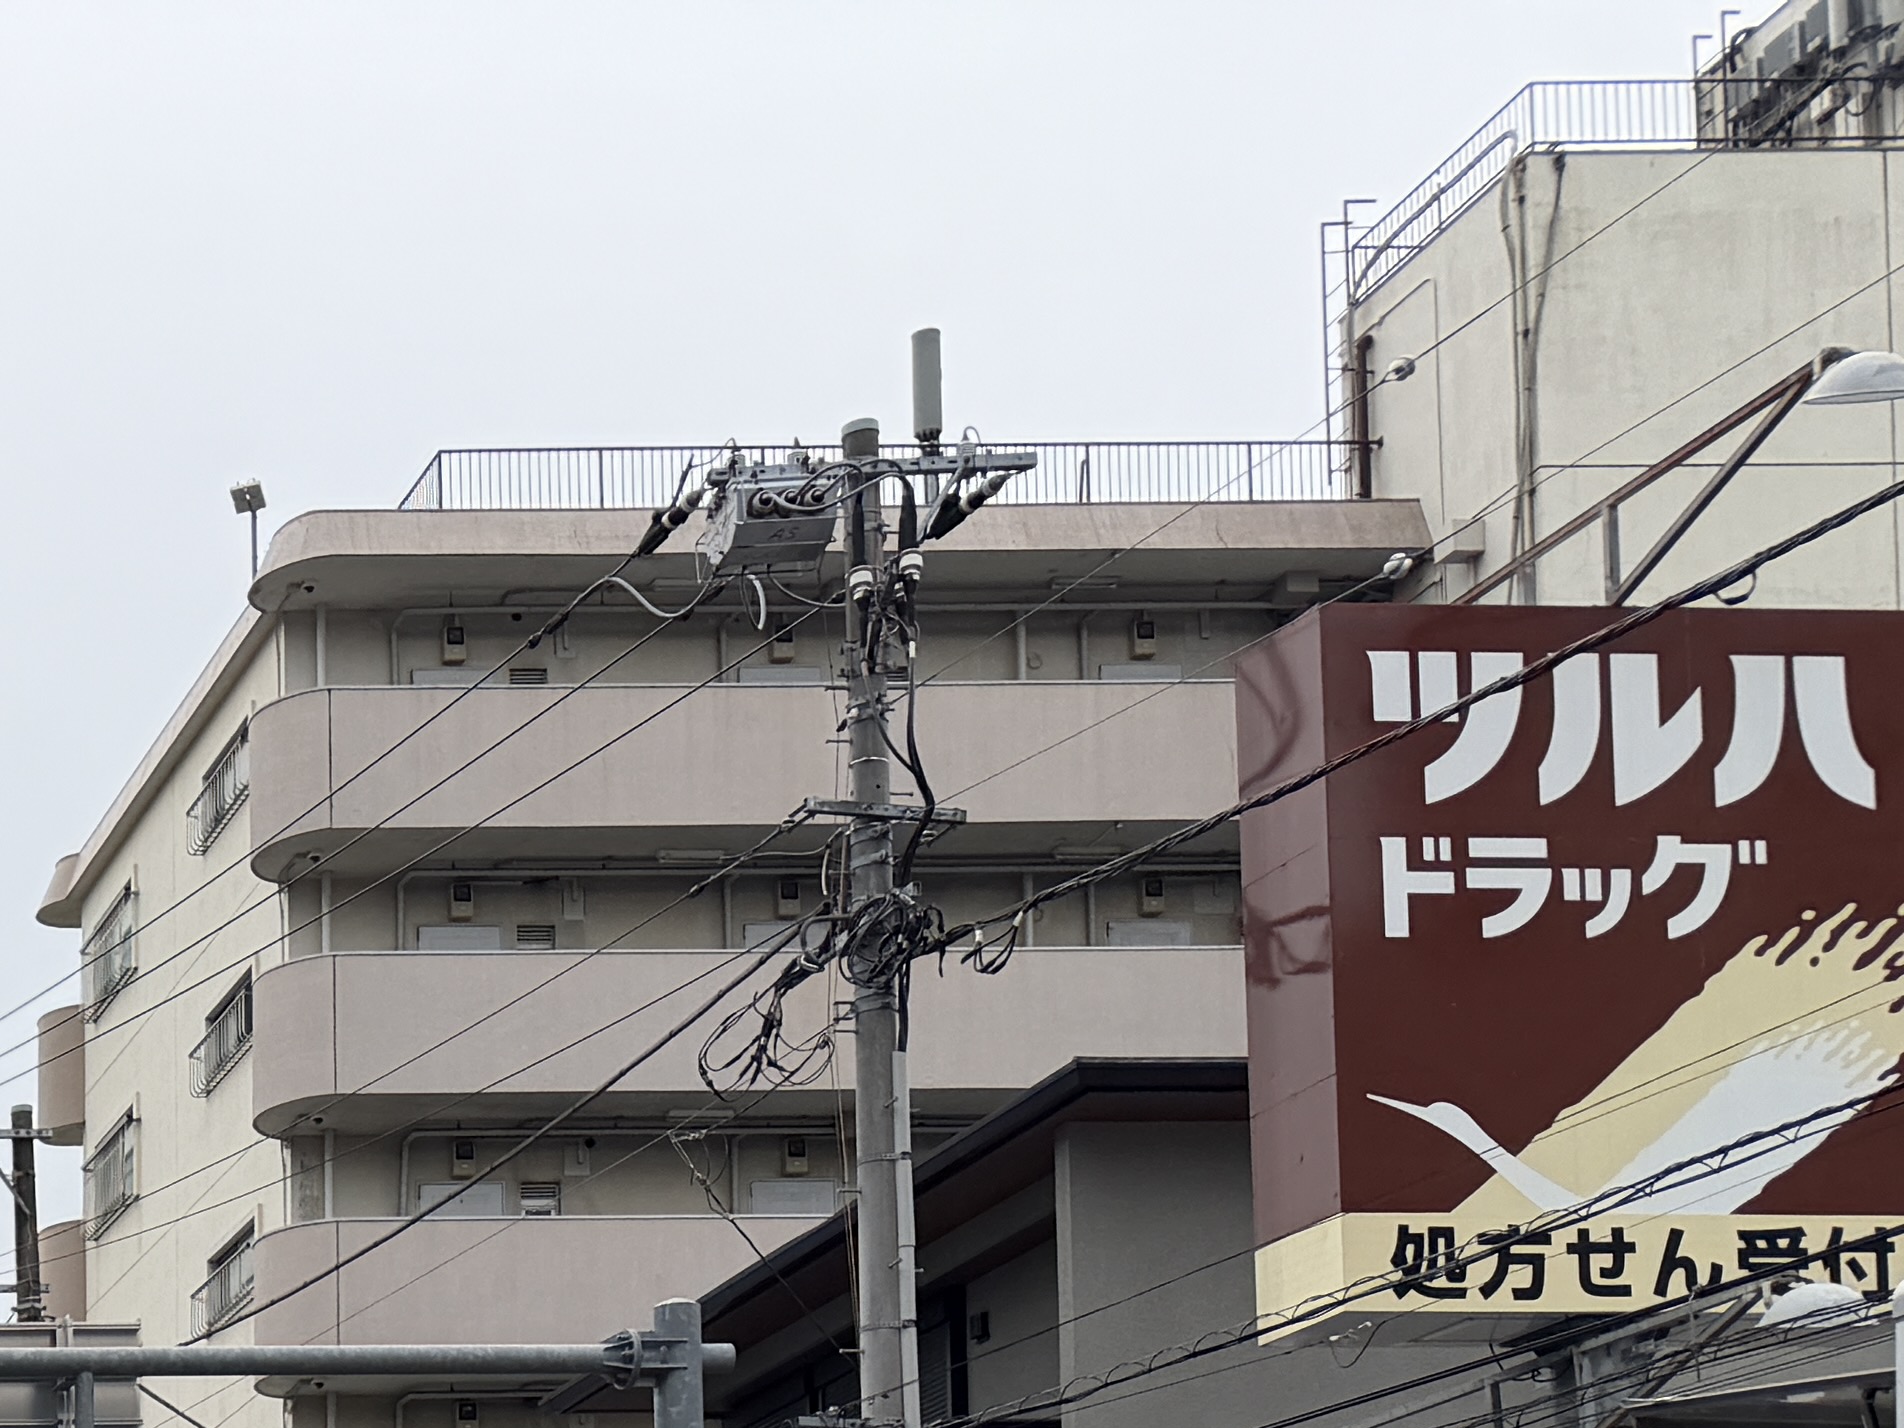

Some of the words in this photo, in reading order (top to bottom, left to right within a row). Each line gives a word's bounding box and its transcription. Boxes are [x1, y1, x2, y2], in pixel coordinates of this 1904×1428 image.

[1367, 650, 1877, 810] ツルハ
[1379, 835, 1769, 940] ドラッグ
[1389, 1223, 1897, 1302] 処方せん受付
